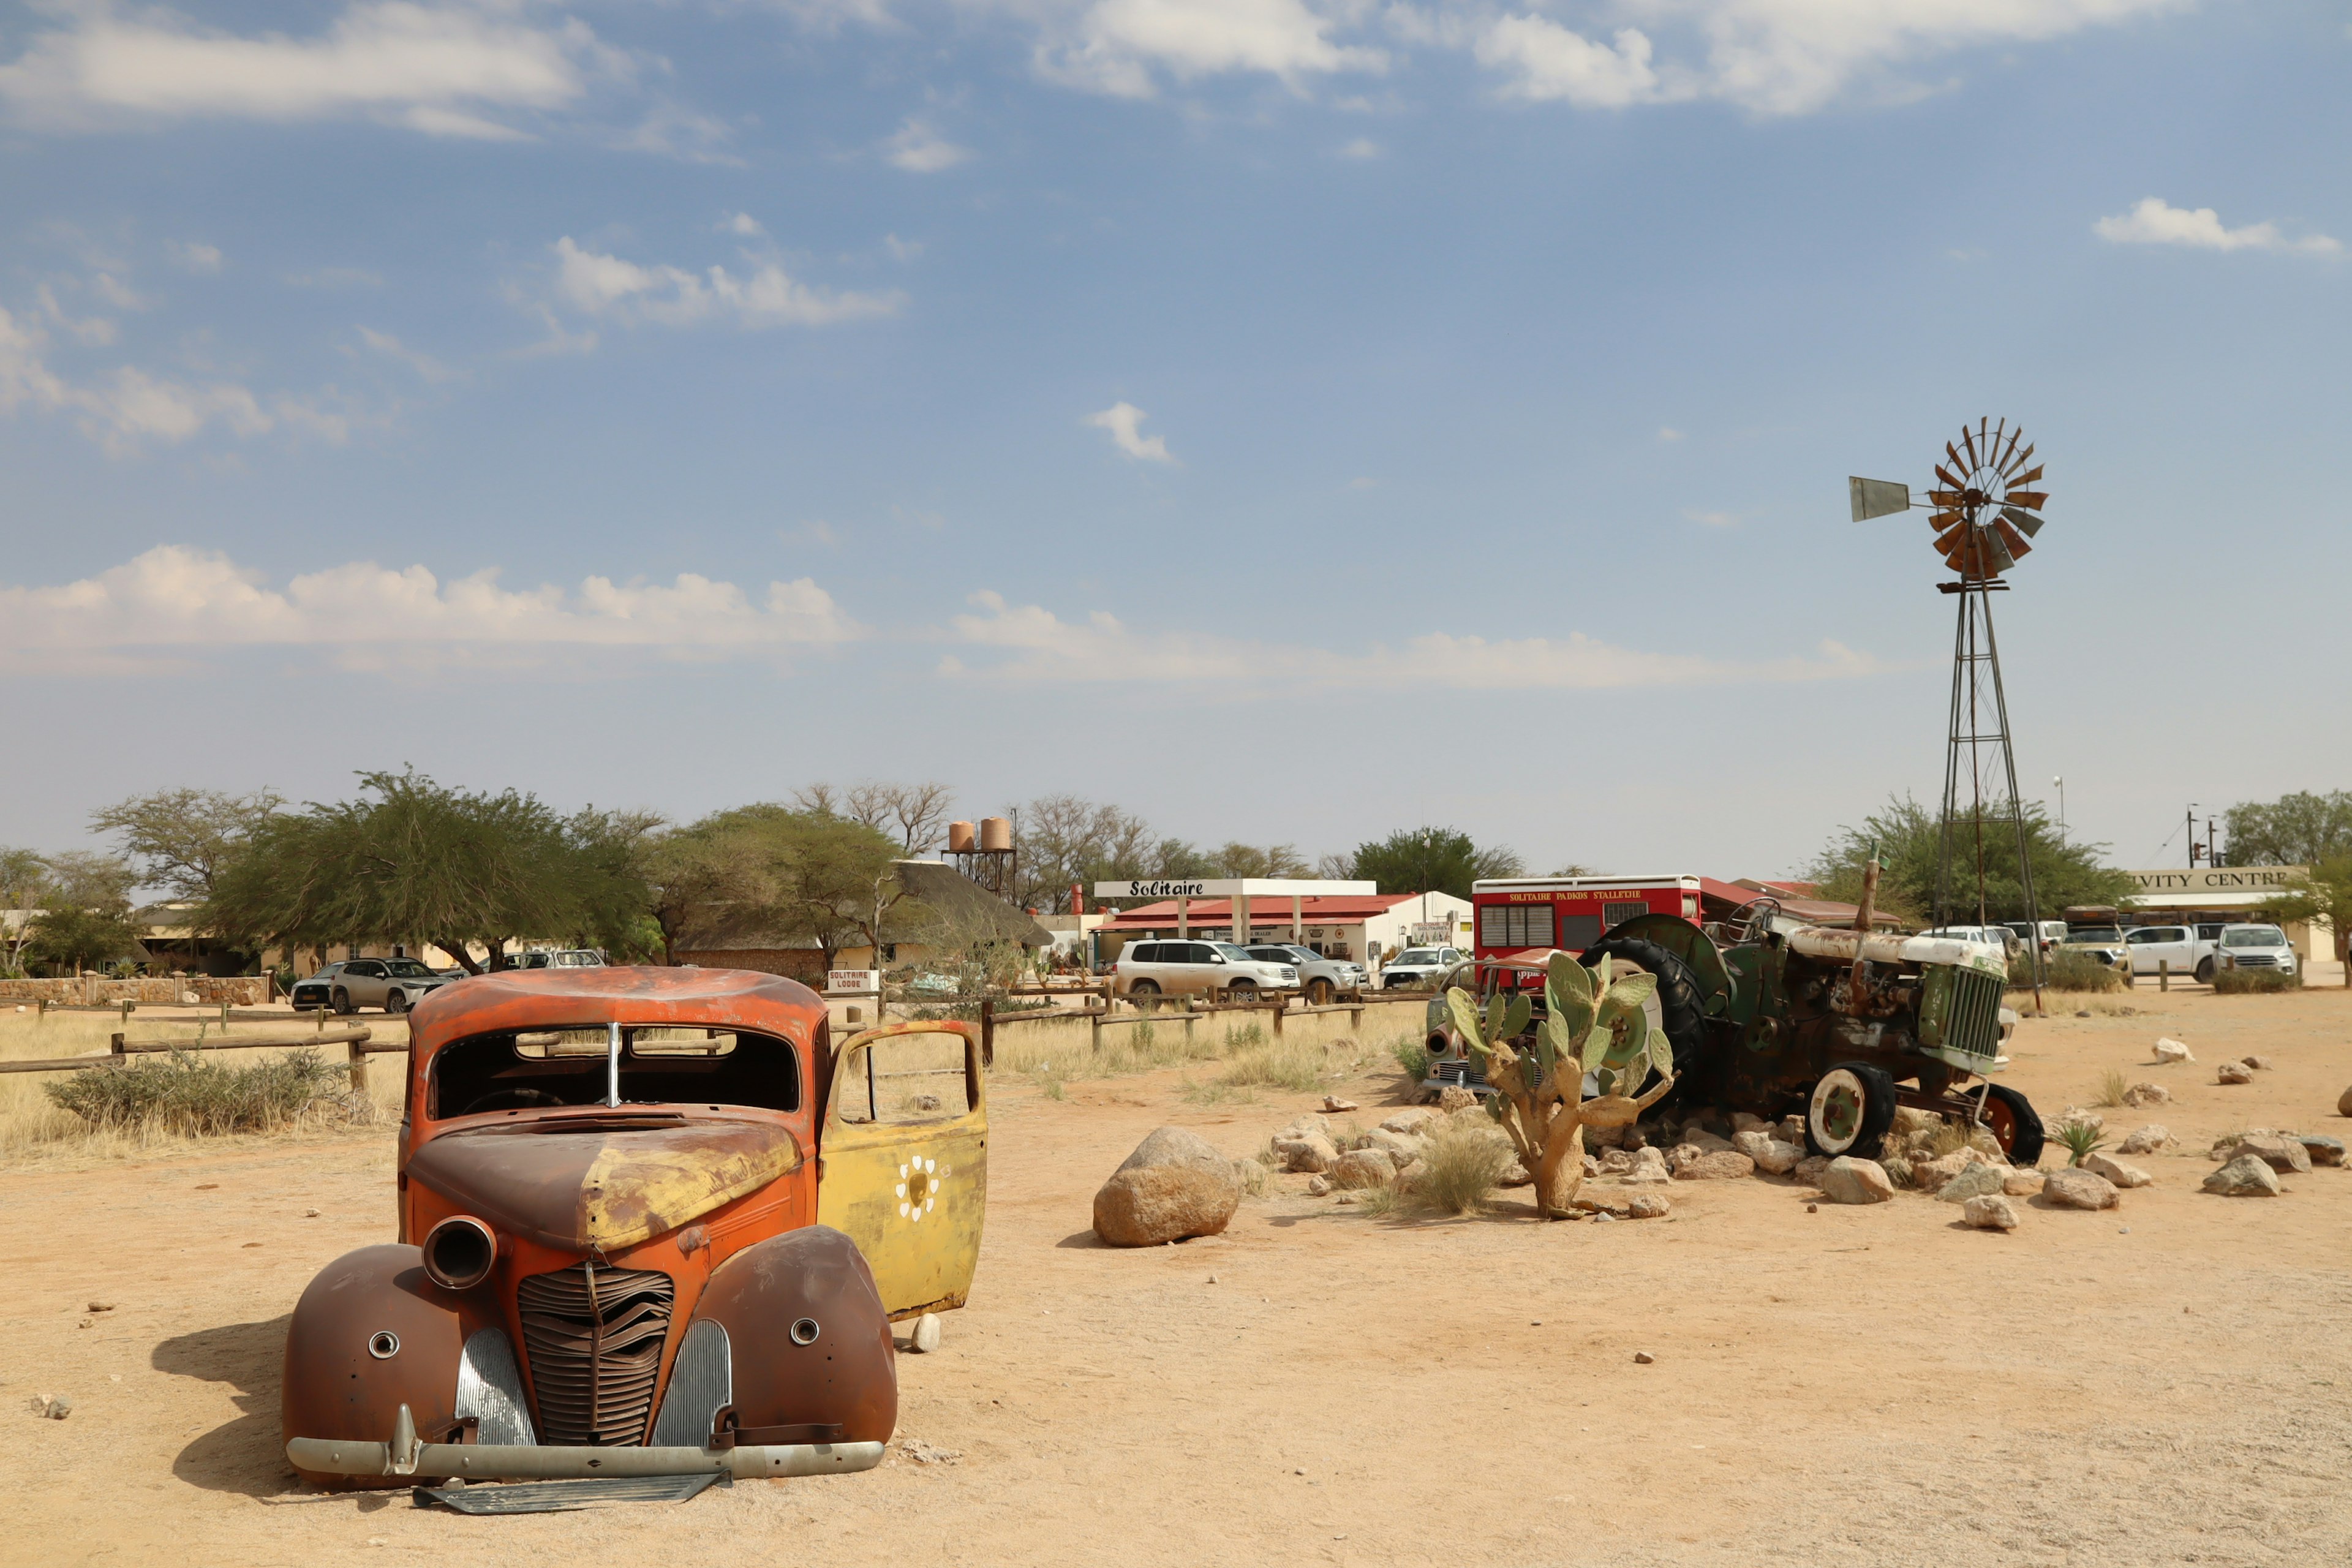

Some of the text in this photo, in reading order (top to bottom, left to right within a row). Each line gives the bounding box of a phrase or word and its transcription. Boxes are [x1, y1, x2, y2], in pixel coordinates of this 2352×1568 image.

[1129, 880, 1204, 895] Solitaire
[2130, 872, 2286, 888] IVITY CENTRE
